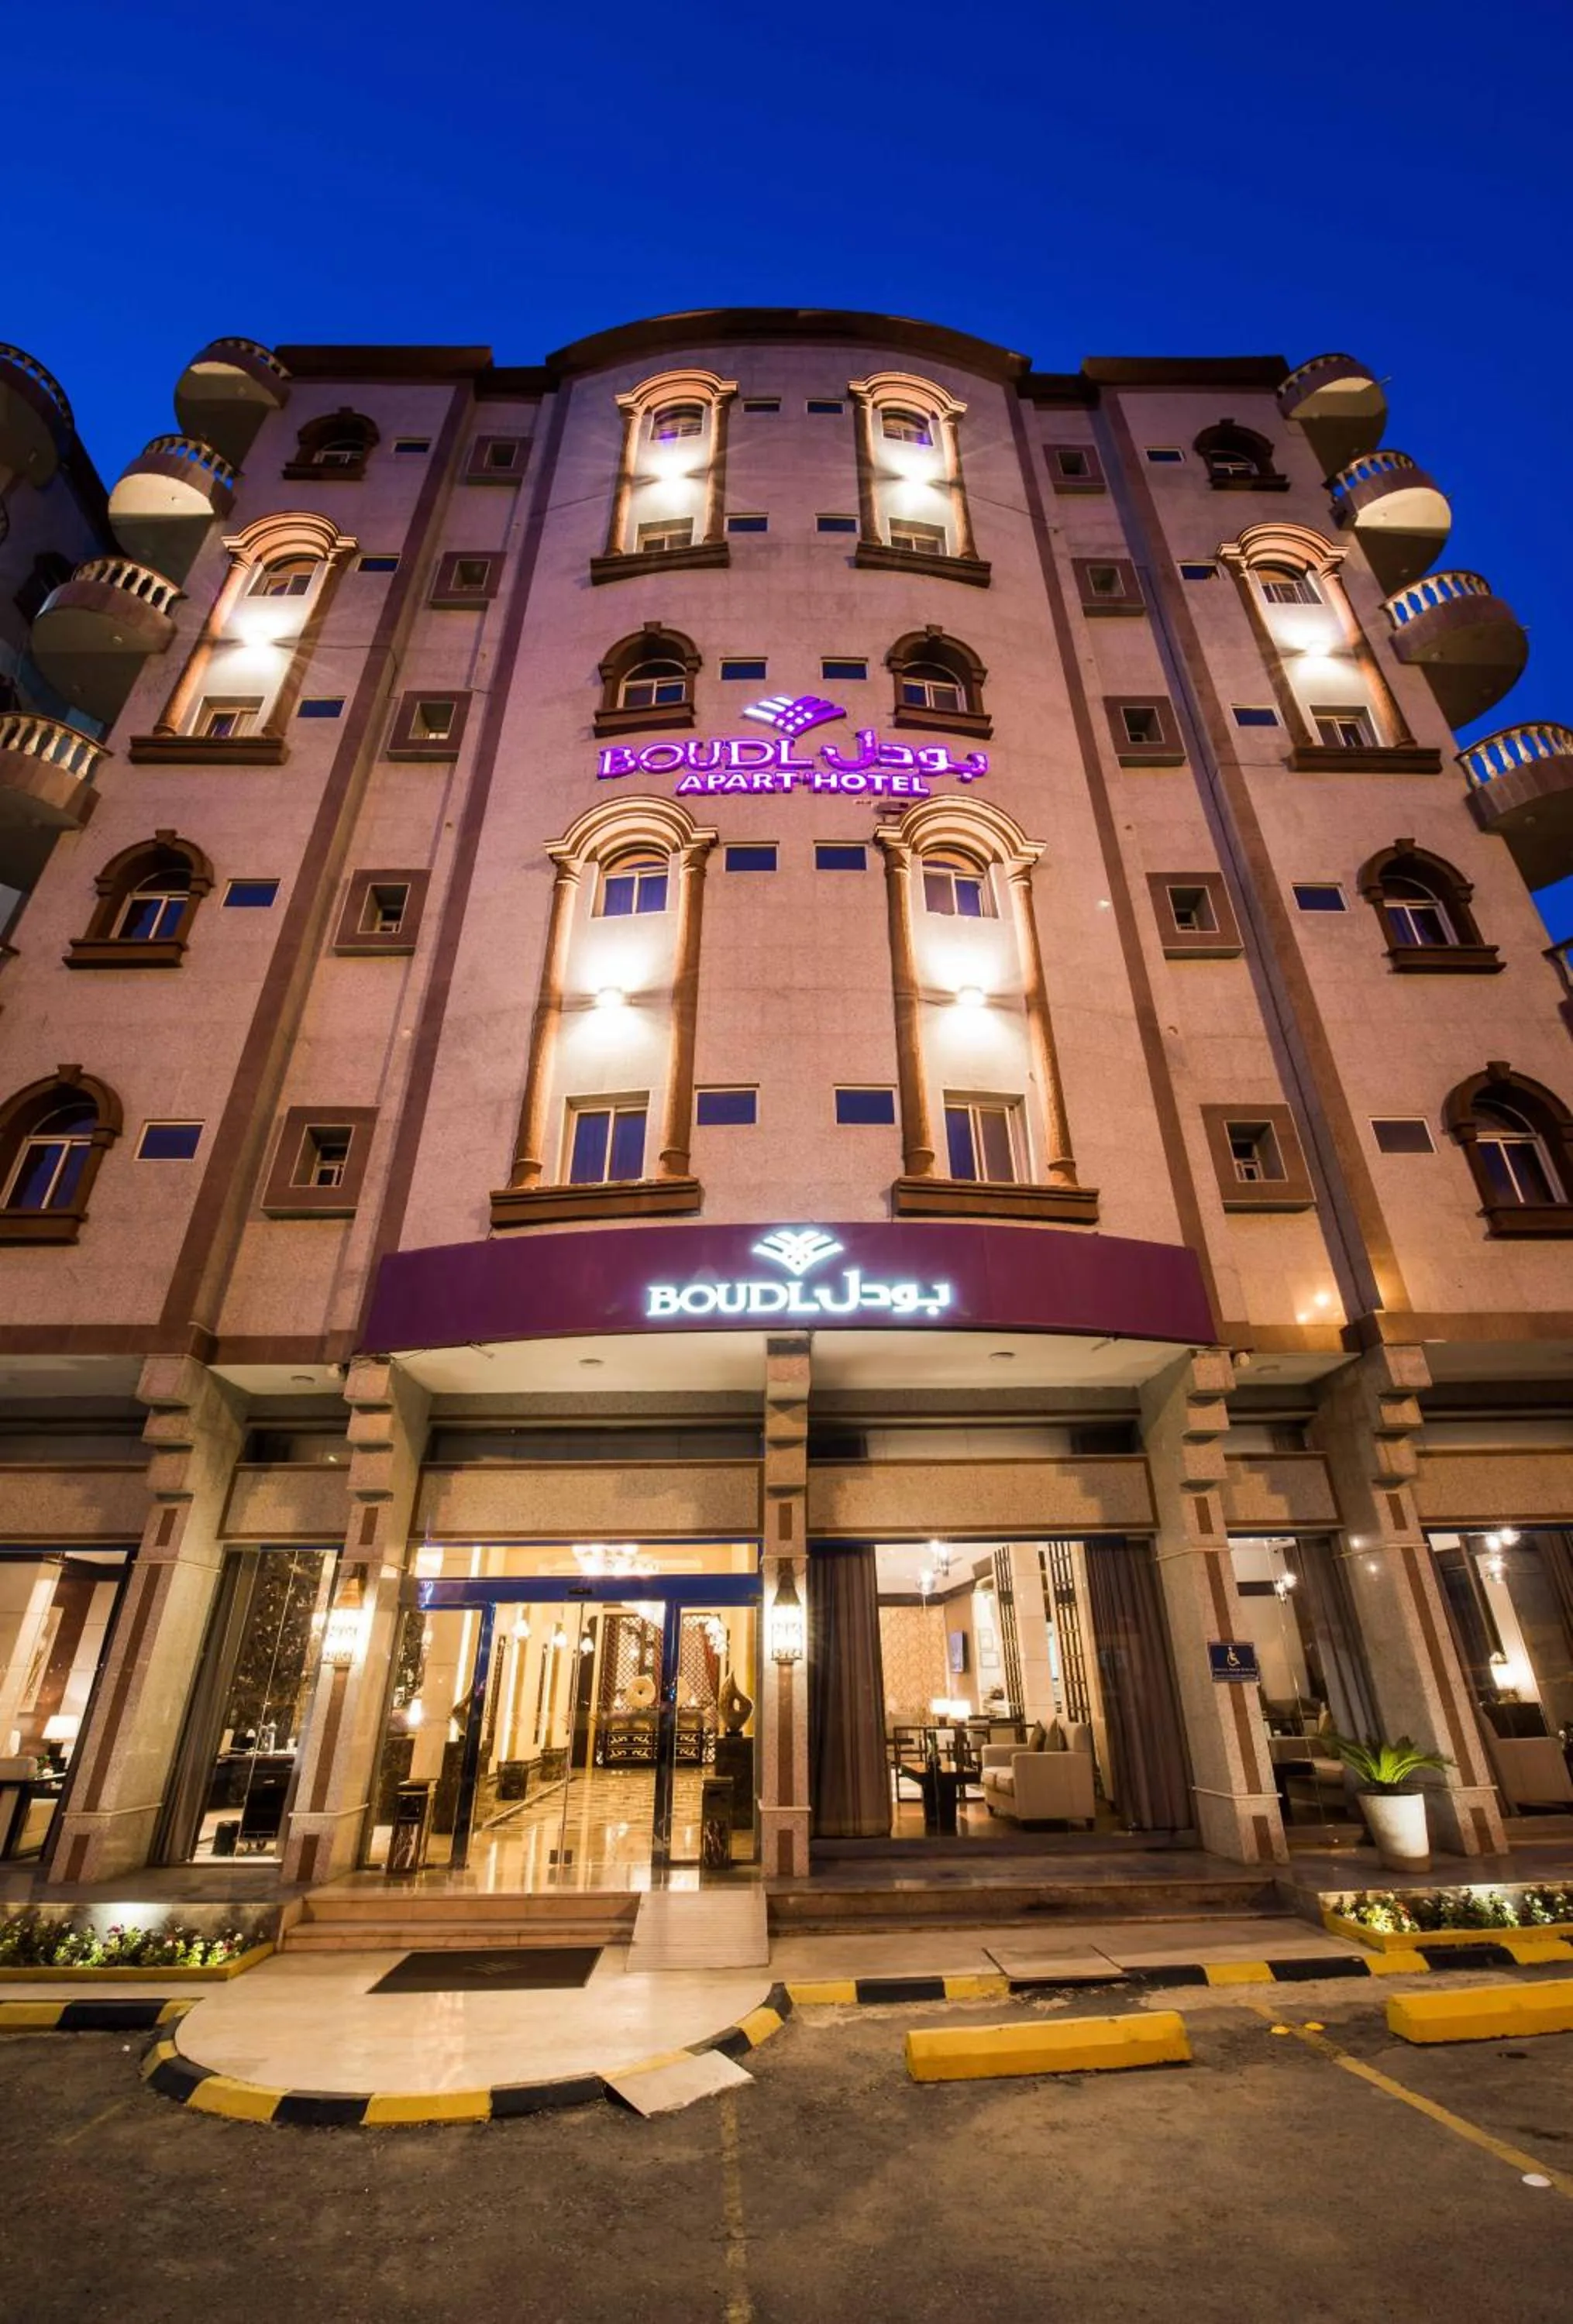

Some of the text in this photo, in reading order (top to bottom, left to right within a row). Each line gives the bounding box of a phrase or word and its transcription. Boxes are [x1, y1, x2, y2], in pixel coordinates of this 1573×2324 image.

[597, 738, 814, 780] BOUDL
[820, 729, 989, 783] بودل
[647, 1281, 823, 1316] BOUDL
[814, 1269, 951, 1315] بودل
